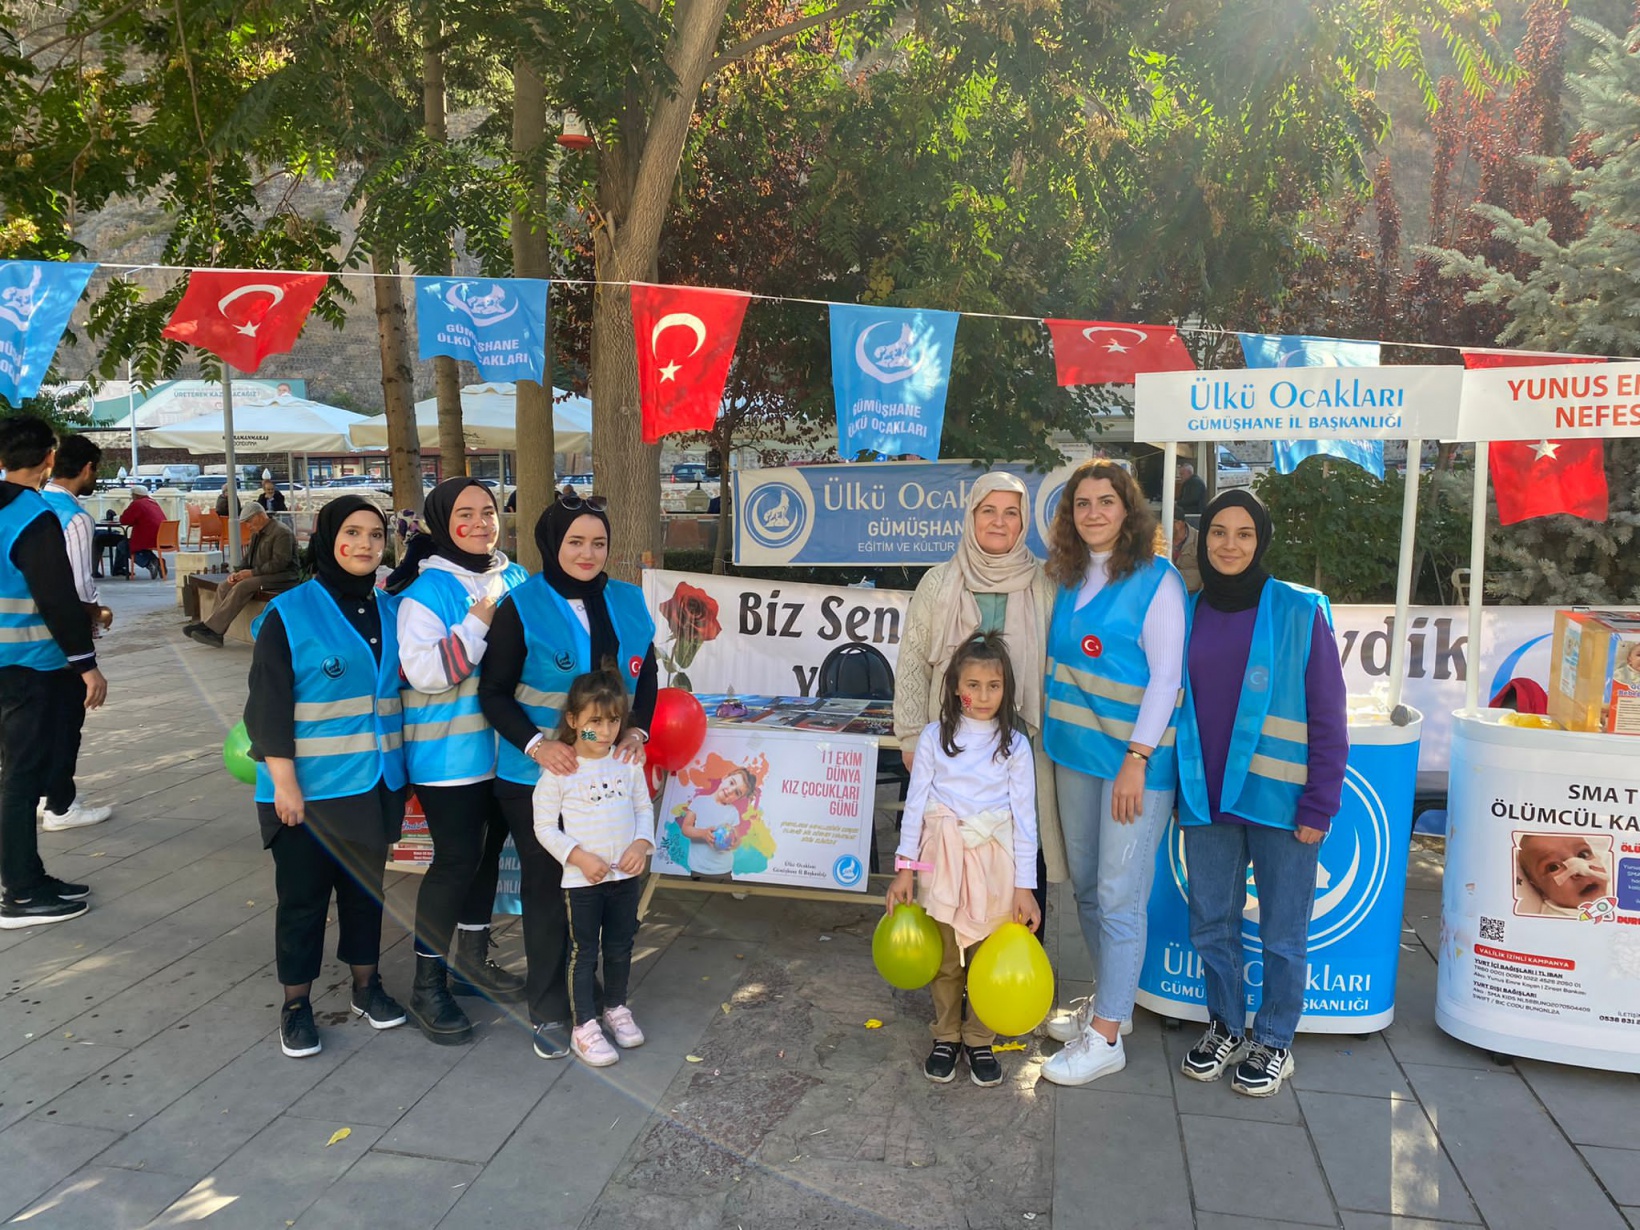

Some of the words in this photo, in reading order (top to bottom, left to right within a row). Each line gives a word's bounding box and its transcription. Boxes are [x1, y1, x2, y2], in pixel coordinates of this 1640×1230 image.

[437, 333, 471, 347] ÜLKÜ
[474, 344, 528, 366] AKLARI
[1190, 377, 1255, 411] Ülkü
[1507, 375, 1609, 401] YUNUS
[853, 398, 921, 418] GÜMÜŞHANE
[1555, 404, 1640, 428] NEFES
[871, 419, 927, 438] OCAKLARI
[1188, 416, 1283, 432] GÜMÜŞHANE
[1289, 414, 1303, 429] İL
[1308, 413, 1402, 432] BAŞKANLIĞI
[824, 477, 885, 511] Ülkü
[858, 541, 893, 552] EĞİTİM
[896, 542, 910, 552] VE
[913, 541, 955, 552] KÜLTÜR
[738, 590, 804, 638] Biz
[836, 749, 862, 767] EKİM
[826, 765, 861, 784] DÜNYA
[781, 779, 799, 794] KIZ
[801, 781, 860, 800] ÇOCUKLARI
[1568, 784, 1619, 803] SMA
[829, 799, 858, 817] GÜNÜ
[1491, 798, 1602, 829] ÖLÜMCÜL
[1163, 941, 1205, 979] Ülk
[1474, 958, 1490, 967] YURT
[1500, 964, 1534, 975] BAĞIŞLARI
[1479, 947, 1505, 958] VALİLİK
[1506, 952, 1527, 962] İZİNLİ
[1528, 957, 1569, 968] KAMPANYA
[1487, 975, 1504, 983] Yunus
[1473, 980, 1489, 989] YURT
[1503, 987, 1537, 998] BAĞIŞLARI
[1301, 996, 1368, 1012] ŞKANLIĞI
